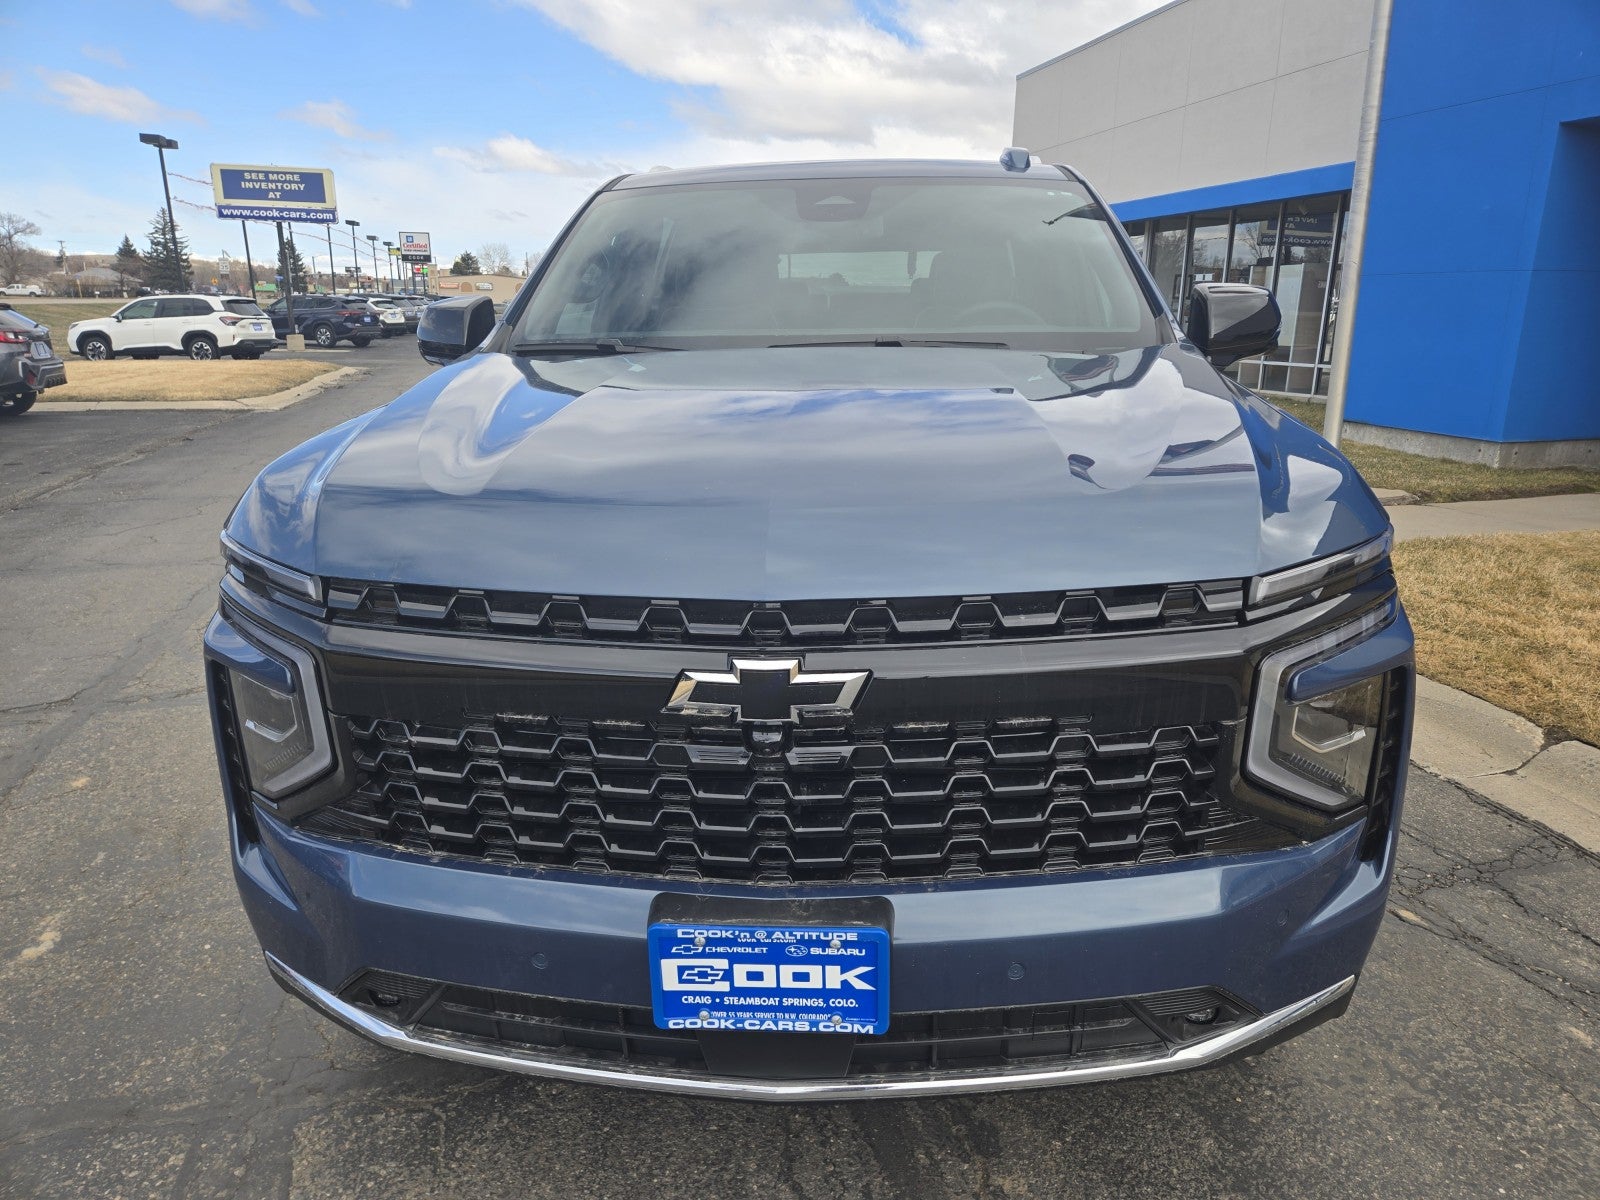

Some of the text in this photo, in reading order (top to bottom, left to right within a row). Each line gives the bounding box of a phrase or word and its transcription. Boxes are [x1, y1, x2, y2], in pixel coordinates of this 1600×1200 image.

[243, 172, 301, 181] SEE MORE
[241, 181, 306, 191] INVENTORY
[268, 191, 282, 199] AT
[221, 208, 334, 220] www.cook-cars.com
[754, 930, 767, 939] @
[771, 931, 858, 941] ALTITUDE
[705, 946, 769, 954] CHEVROLET
[809, 947, 866, 956] SUBARU
[660, 958, 877, 992] COOK
[681, 995, 859, 1008] CRAIG STEAMBOAT SPRINGS, COLO.
[668, 1018, 874, 1034] COOK-CARS.COM
